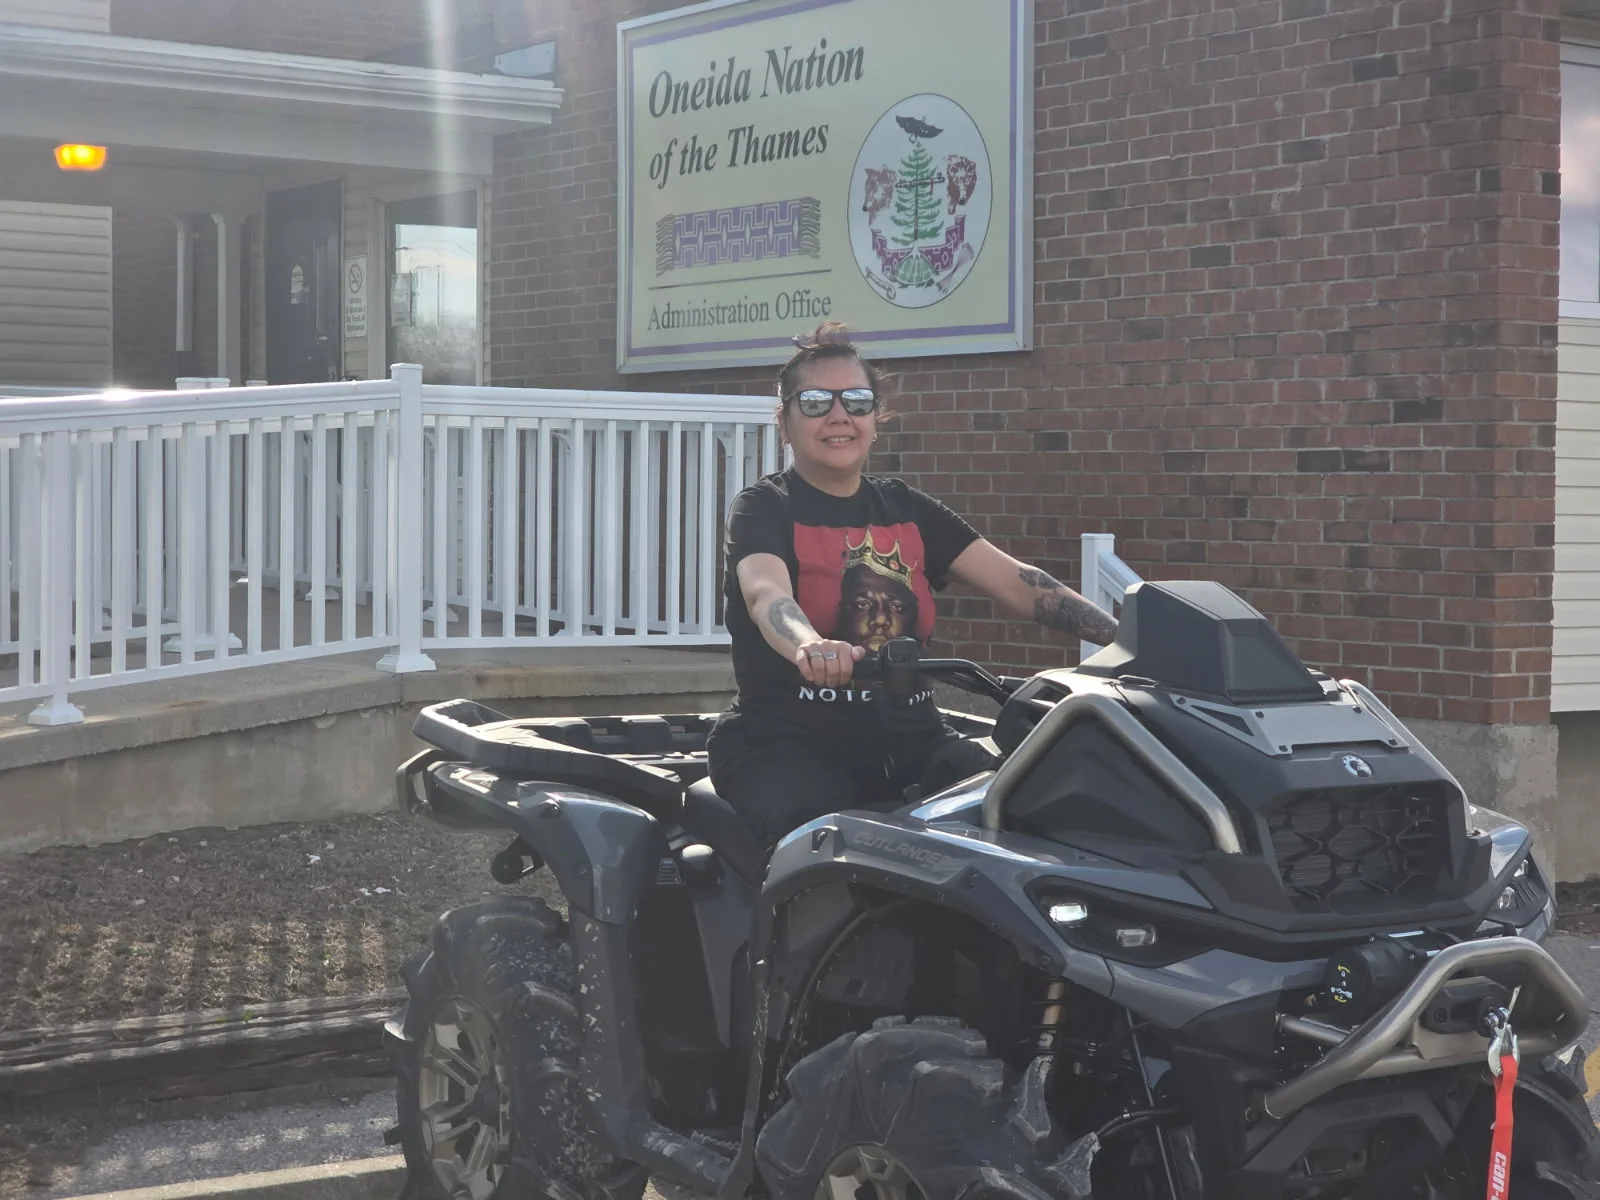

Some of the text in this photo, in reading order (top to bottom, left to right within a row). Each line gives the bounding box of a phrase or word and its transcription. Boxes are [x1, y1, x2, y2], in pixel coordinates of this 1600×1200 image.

[649, 37, 864, 118] Oneida Nation
[649, 124, 829, 189] of the Thames
[648, 289, 832, 331] Administration Office
[852, 831, 952, 868] OUTLANDE
